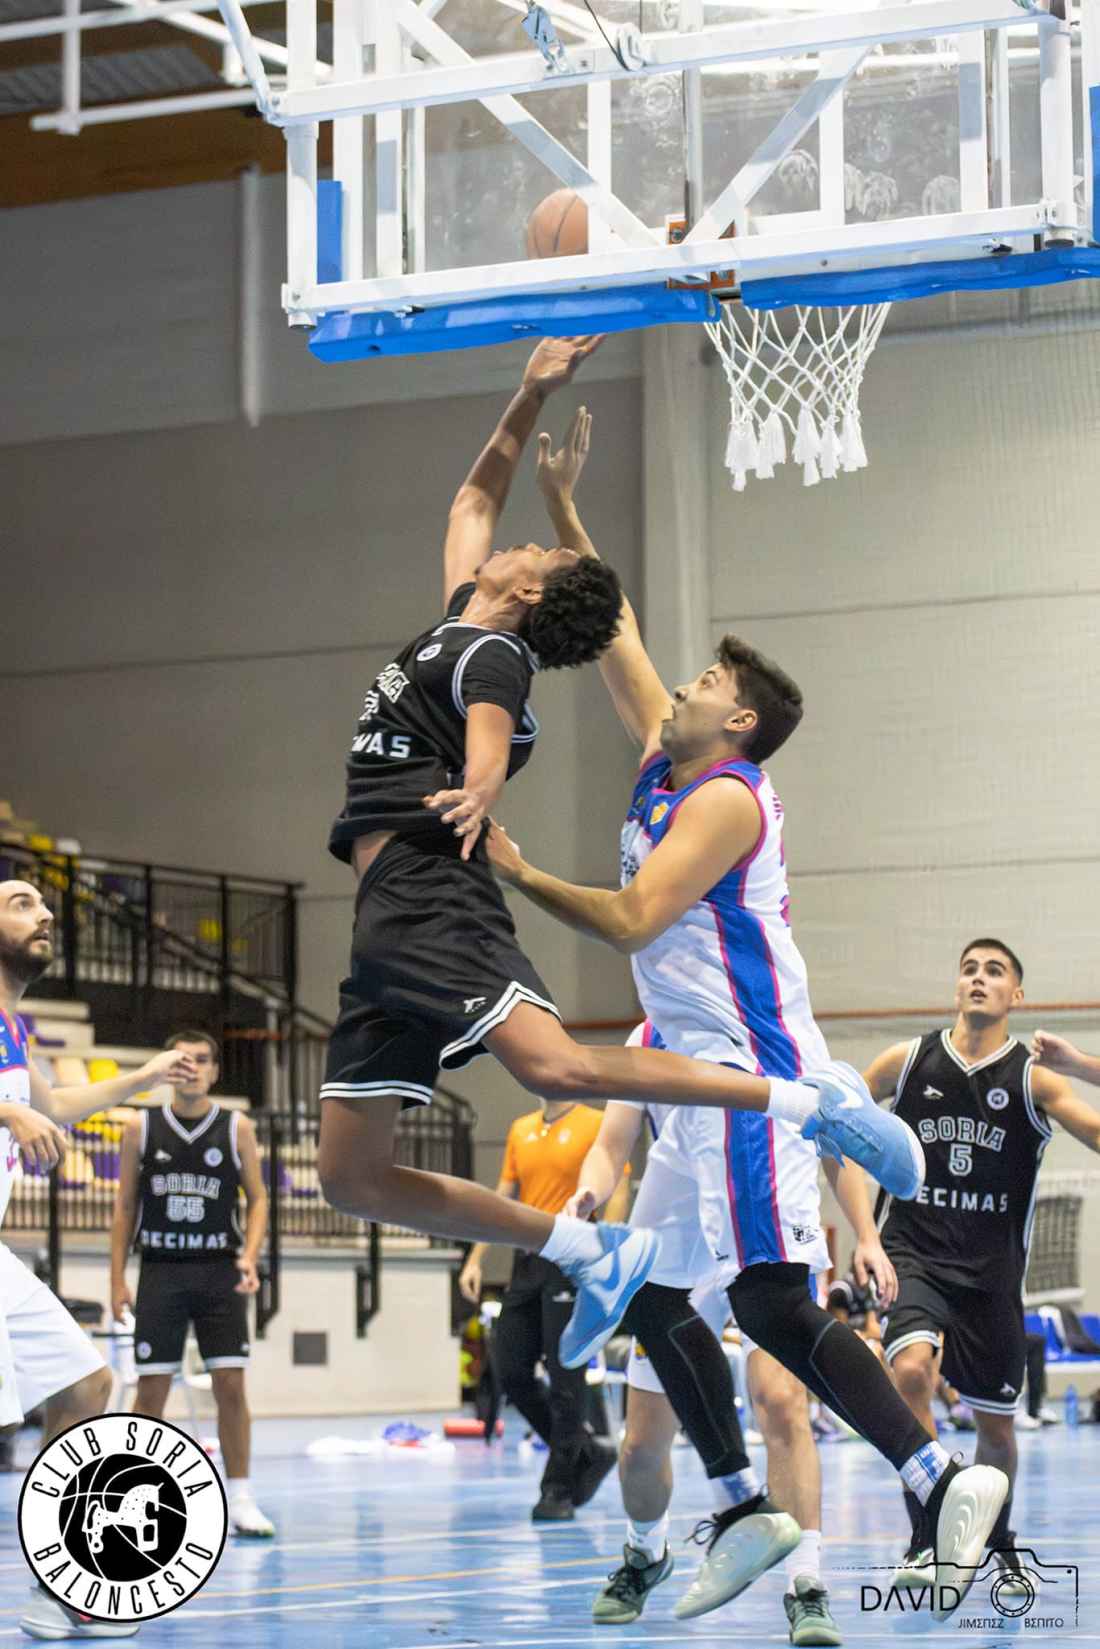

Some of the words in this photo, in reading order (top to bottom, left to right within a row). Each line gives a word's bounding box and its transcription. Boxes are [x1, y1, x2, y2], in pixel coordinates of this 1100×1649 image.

[919, 1116, 1005, 1151] SORIA
[949, 1145, 973, 1176] 5
[151, 1174, 220, 1199] SORIA
[915, 1187, 1007, 1211] ECIMAS
